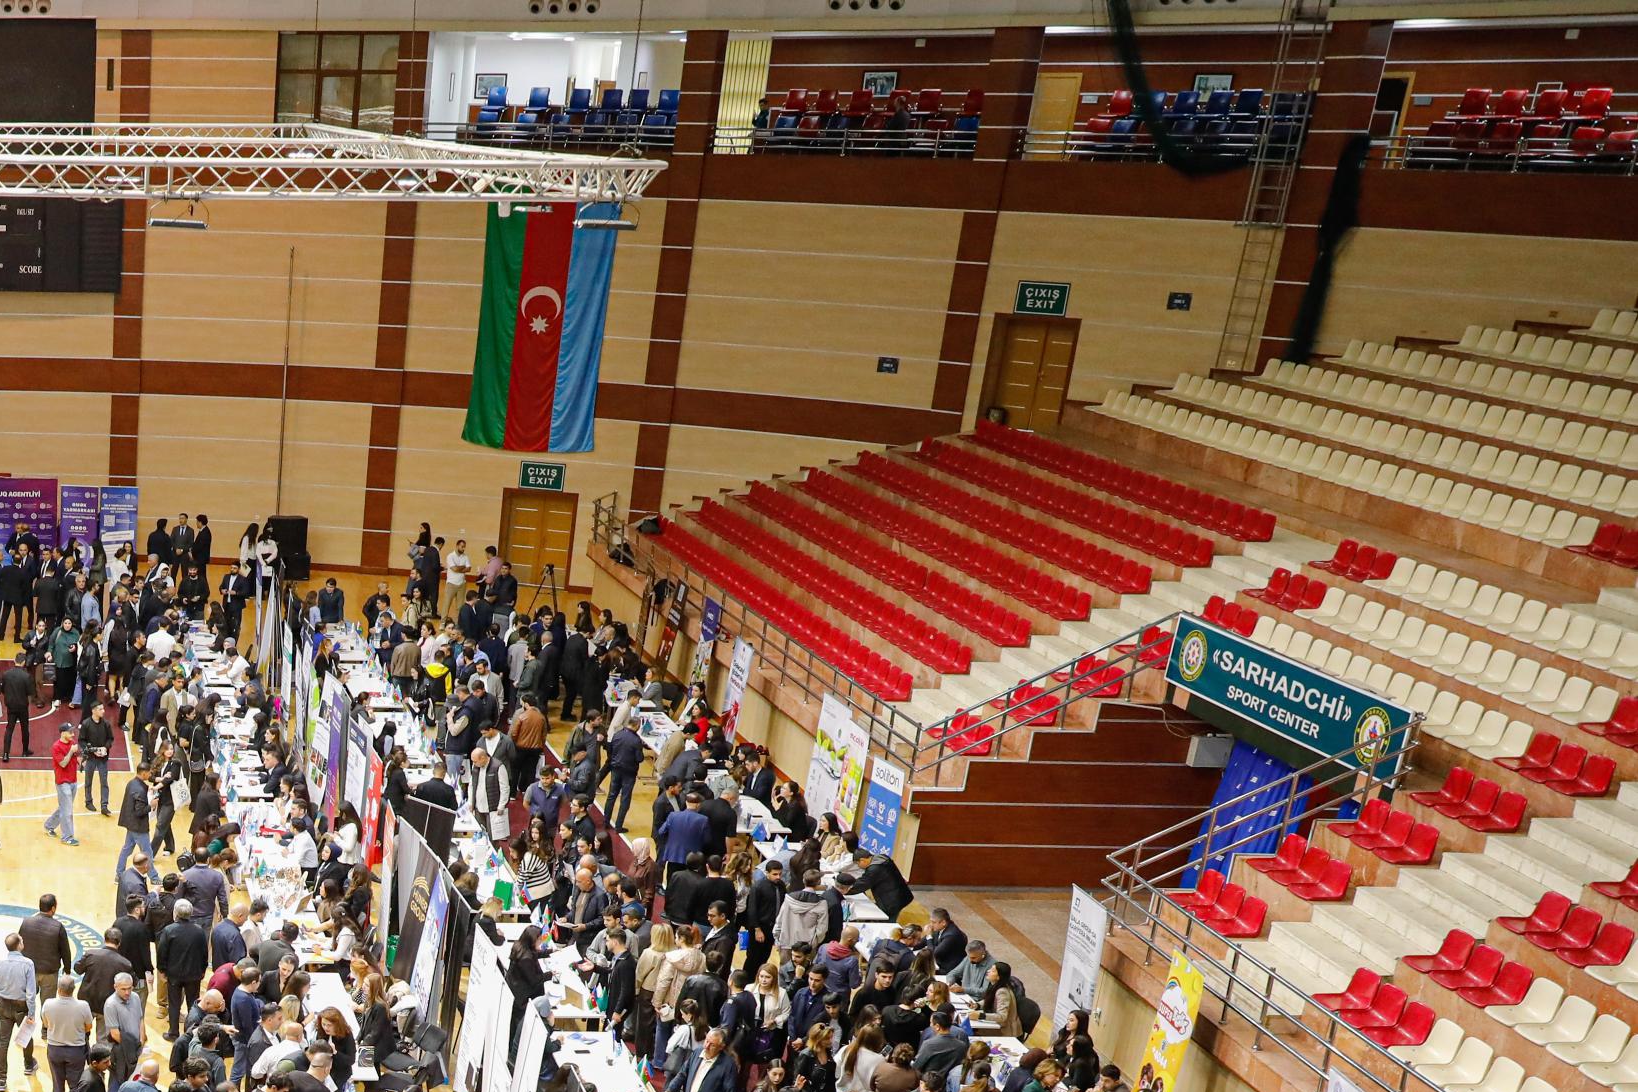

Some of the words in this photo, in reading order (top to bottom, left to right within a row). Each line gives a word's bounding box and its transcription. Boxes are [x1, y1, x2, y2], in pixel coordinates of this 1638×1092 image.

[19, 265, 42, 274] SCORE
[1025, 287, 1060, 300] ÇIXIŞ
[1026, 298, 1056, 310] EXIT
[527, 465, 559, 477] ÇIXIŞ
[528, 476, 556, 486] EXIT
[8, 489, 41, 498] AGENTLİYİ
[1227, 685, 1268, 714] SPORT
[1268, 704, 1319, 739] CENTER
[410, 899, 426, 923] GROUP
